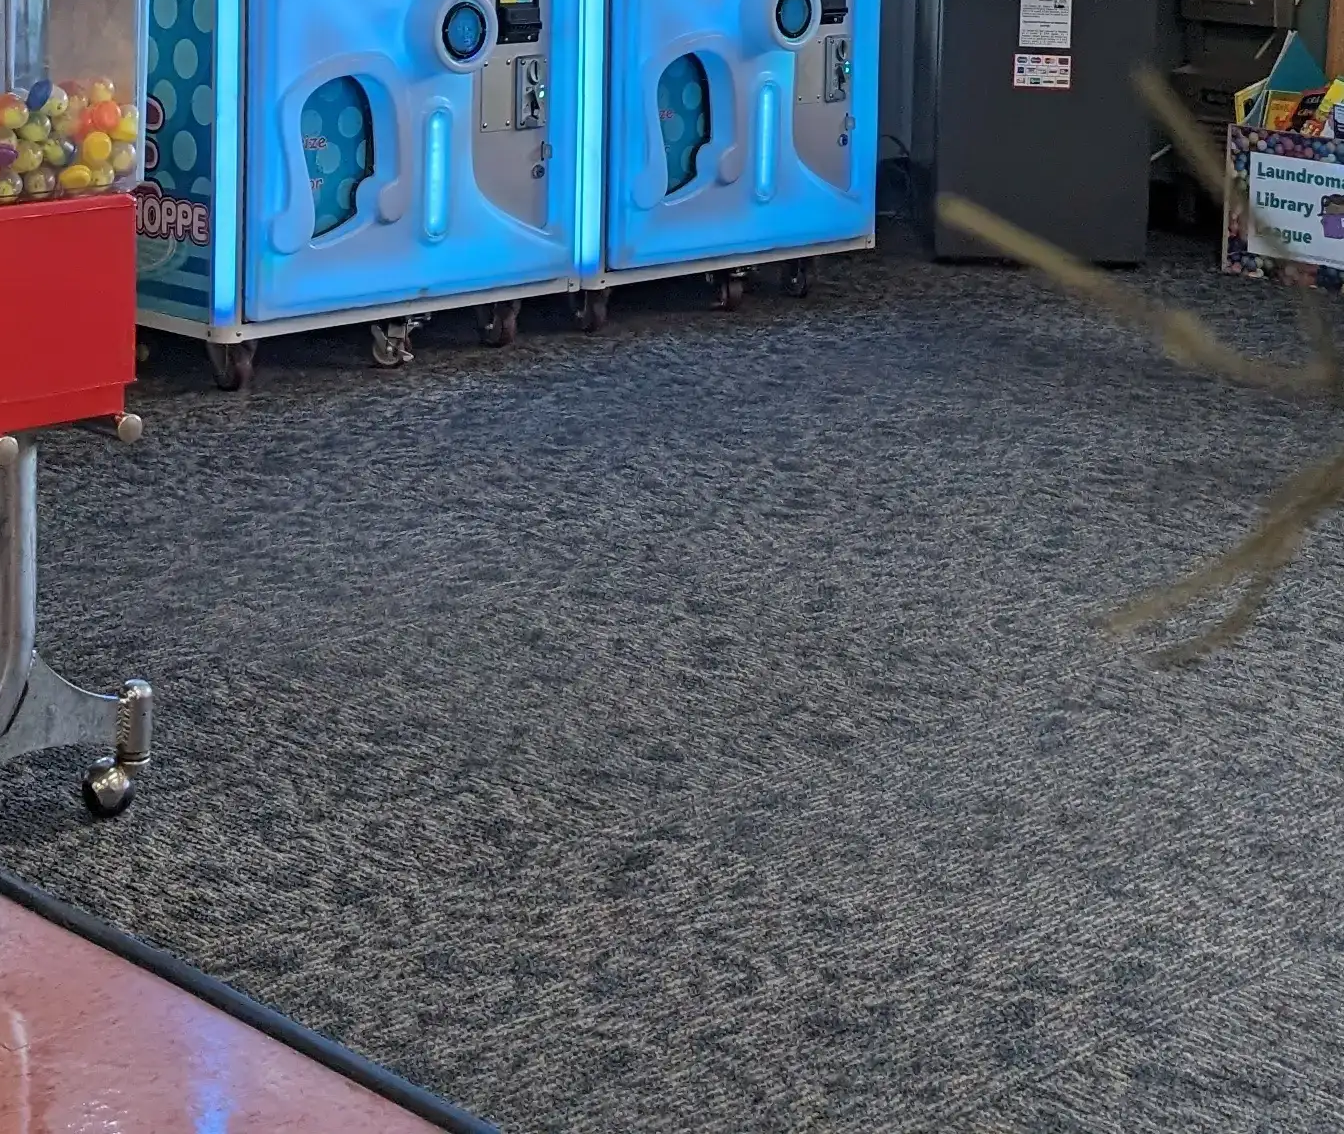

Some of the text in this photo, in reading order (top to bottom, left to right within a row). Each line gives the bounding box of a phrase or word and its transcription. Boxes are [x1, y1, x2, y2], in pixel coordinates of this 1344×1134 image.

[305, 134, 327, 150] ize
[1256, 190, 1315, 218] Library
[136, 192, 210, 246] HOPPE
